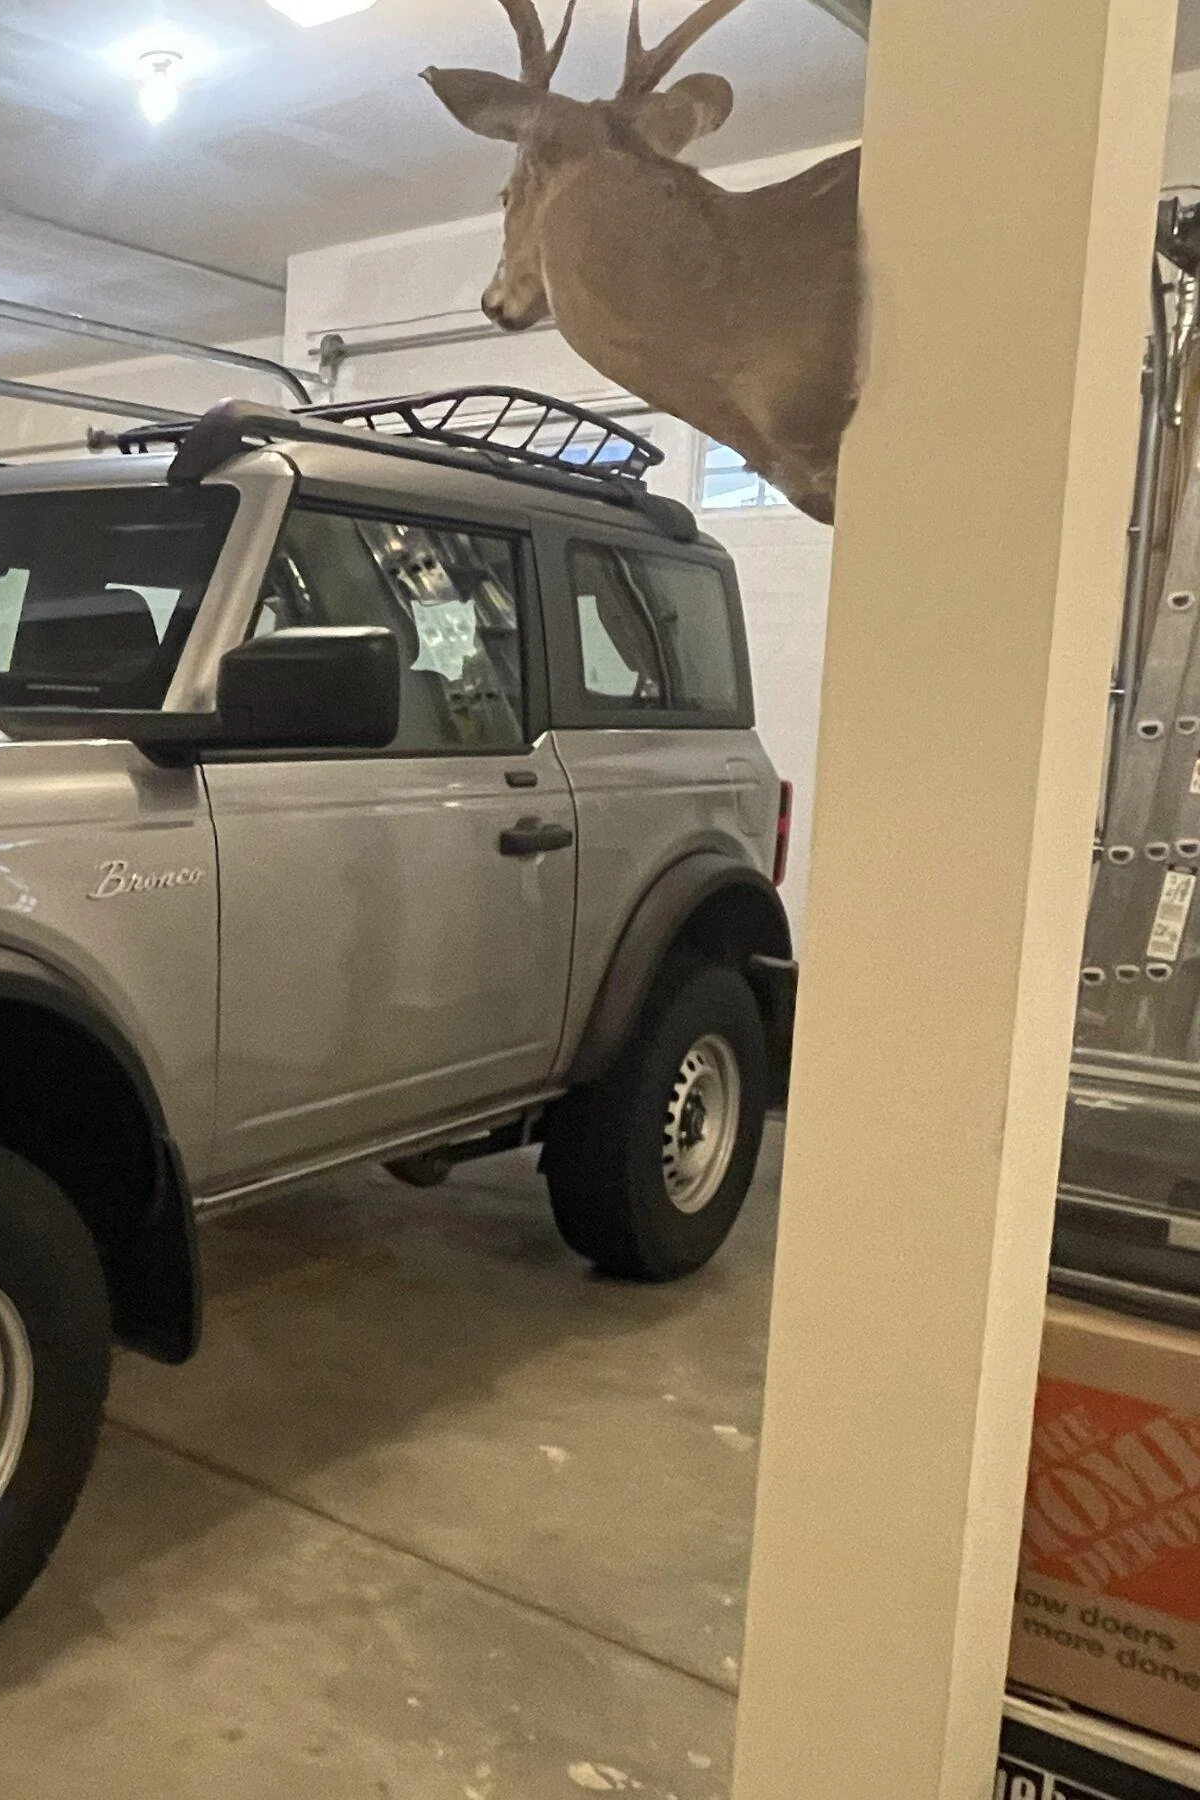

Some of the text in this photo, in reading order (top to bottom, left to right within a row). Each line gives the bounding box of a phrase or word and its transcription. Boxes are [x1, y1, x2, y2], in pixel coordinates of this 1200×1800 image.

[85, 859, 206, 900] Bronco
[1022, 1617, 1105, 1659] more
[1079, 1606, 1175, 1652] doers
